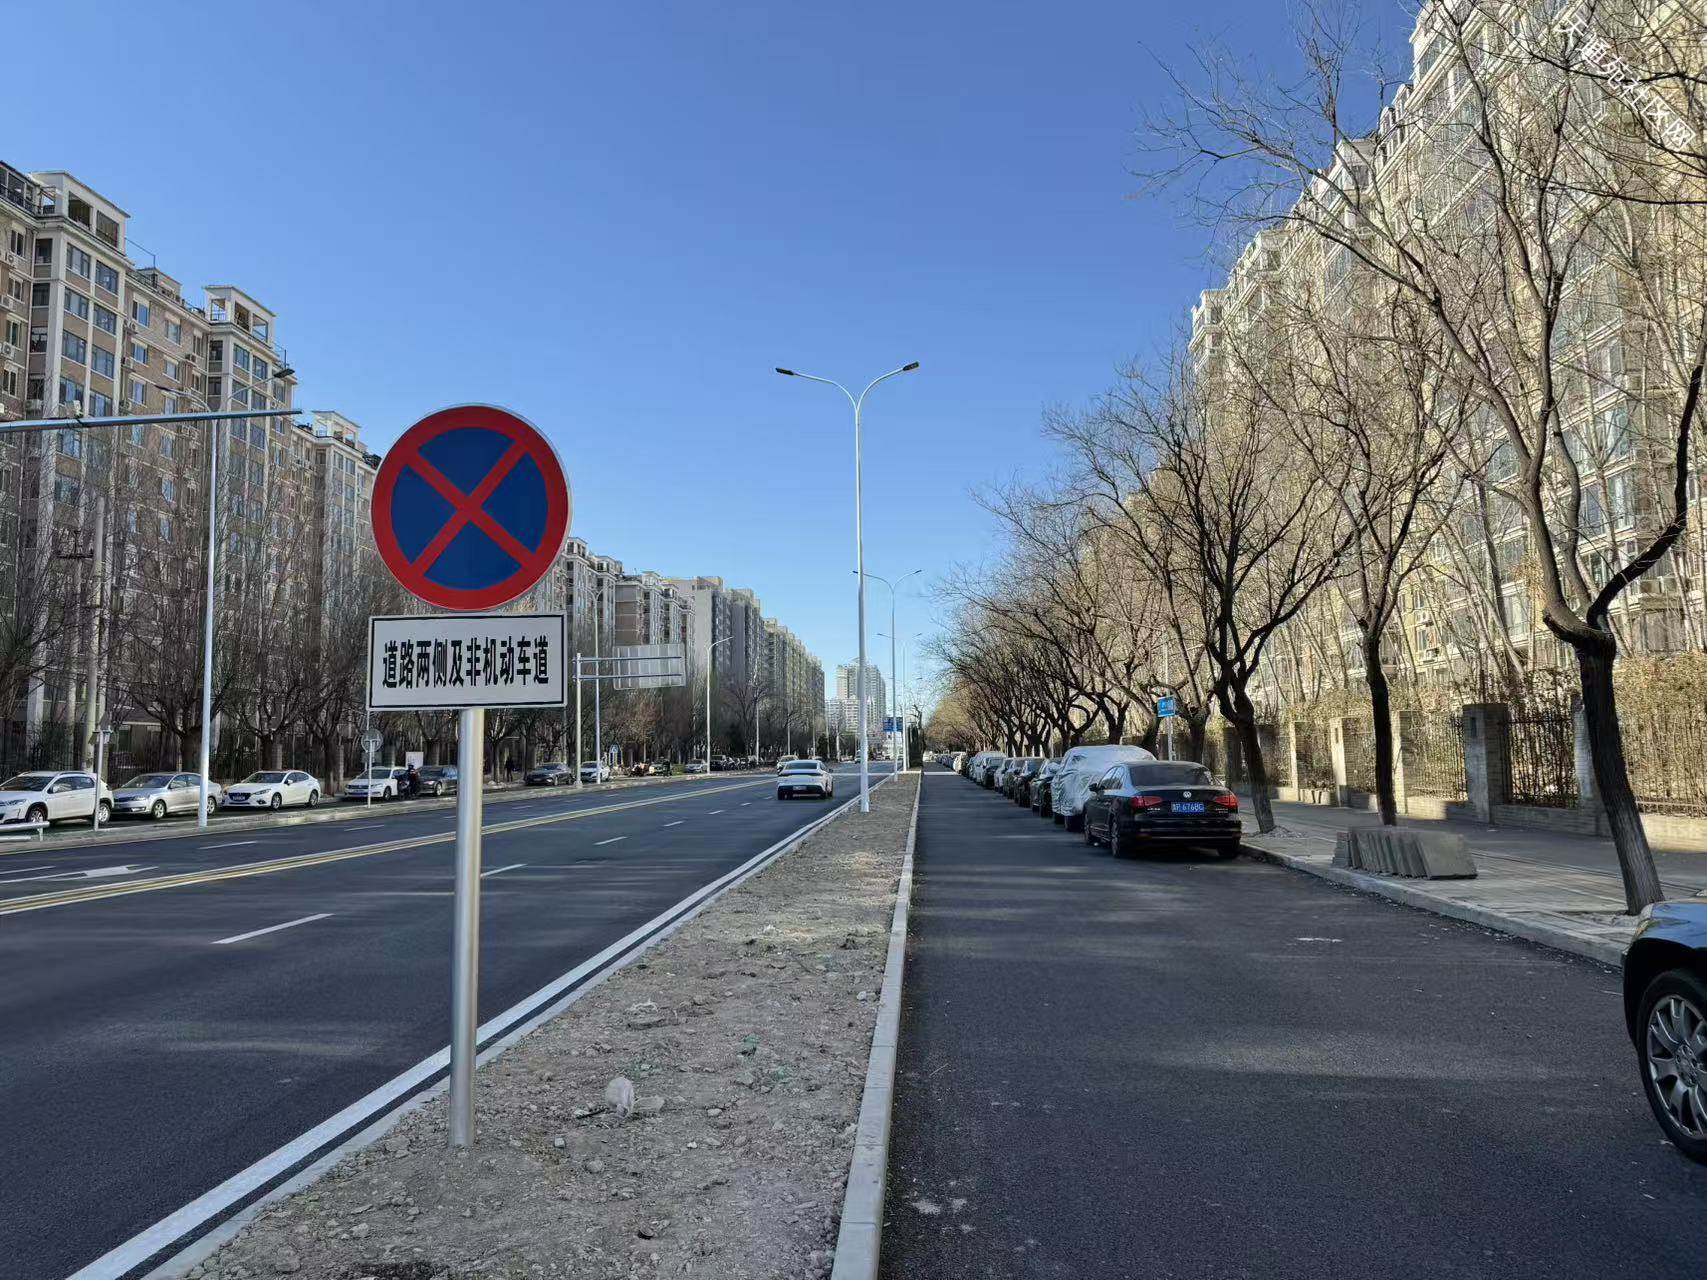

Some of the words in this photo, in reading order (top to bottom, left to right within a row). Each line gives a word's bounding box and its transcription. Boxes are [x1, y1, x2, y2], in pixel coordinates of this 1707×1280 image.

[382, 635, 549, 689] 道路两侧及非机动车道
